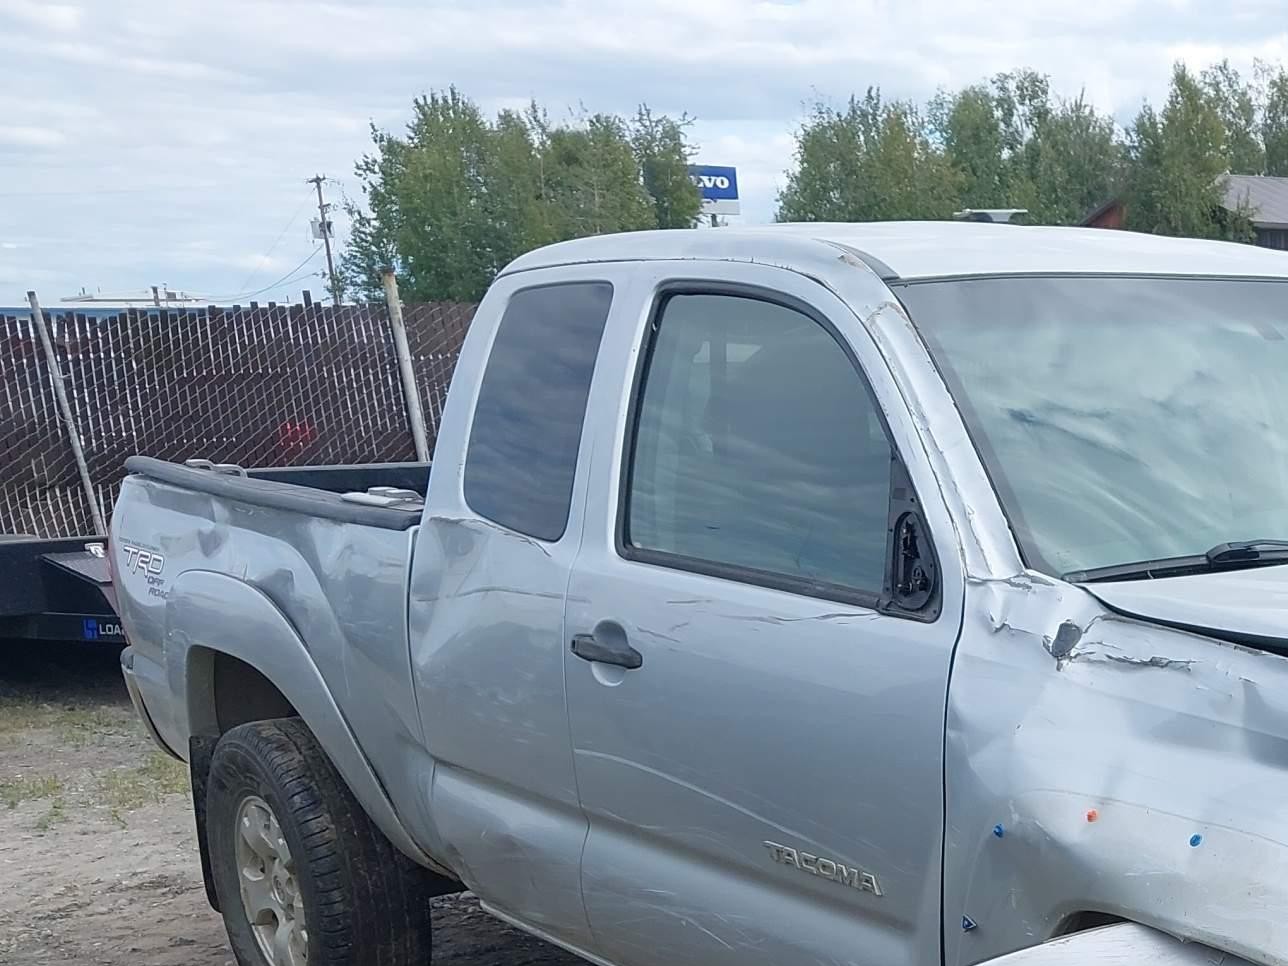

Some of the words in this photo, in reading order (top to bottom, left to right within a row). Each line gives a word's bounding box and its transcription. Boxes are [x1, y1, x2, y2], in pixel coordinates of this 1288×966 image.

[123, 545, 164, 578] TRD
[99, 623, 125, 636] LOA
[762, 840, 882, 896] TACOMA
